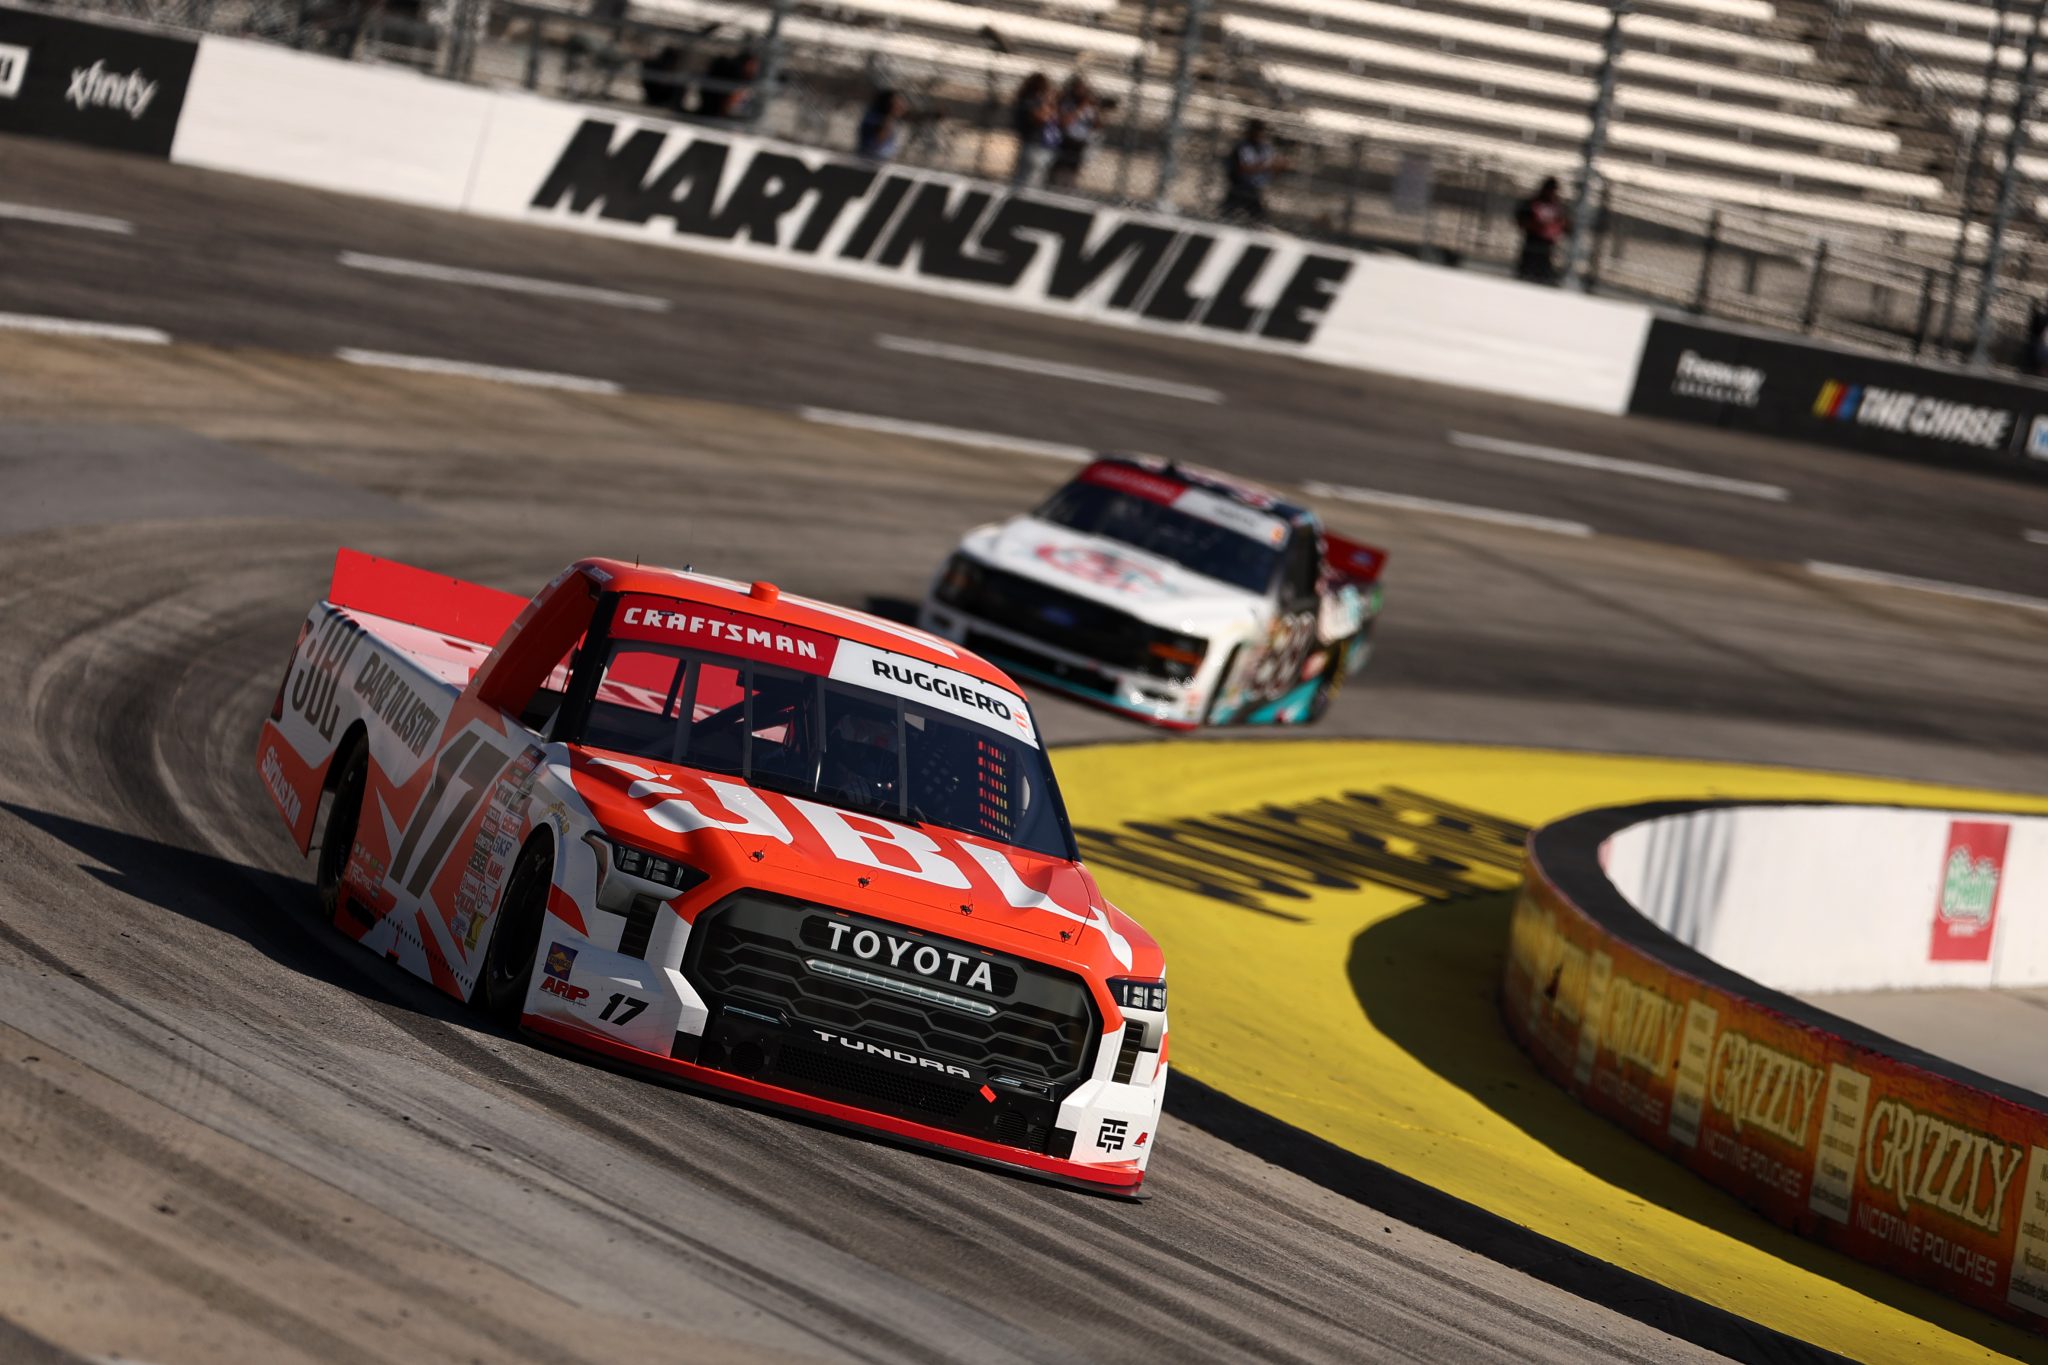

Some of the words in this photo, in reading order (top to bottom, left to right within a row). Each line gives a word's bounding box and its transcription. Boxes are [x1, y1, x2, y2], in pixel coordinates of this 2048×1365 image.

[64, 58, 159, 120] xfinity
[530, 117, 1358, 345] MARTINSVILLE
[1856, 384, 1916, 433] THE
[1909, 397, 2012, 450] CHASE
[623, 606, 818, 661] CRAFTSMAN
[872, 658, 1012, 722] RUGGIERO
[389, 729, 510, 899] 17
[643, 776, 1132, 973] JBL
[541, 975, 590, 1001] ARP
[827, 920, 995, 993] TOYOTA
[598, 992, 649, 1026] 17
[813, 1029, 971, 1079] TUNDRA
[1711, 1032, 1823, 1149] GRIZZLY
[1864, 1099, 2023, 1234] GRIZZLY
[1856, 1202, 1921, 1254] NICOTINE
[1923, 1230, 1998, 1288] POUCHES
